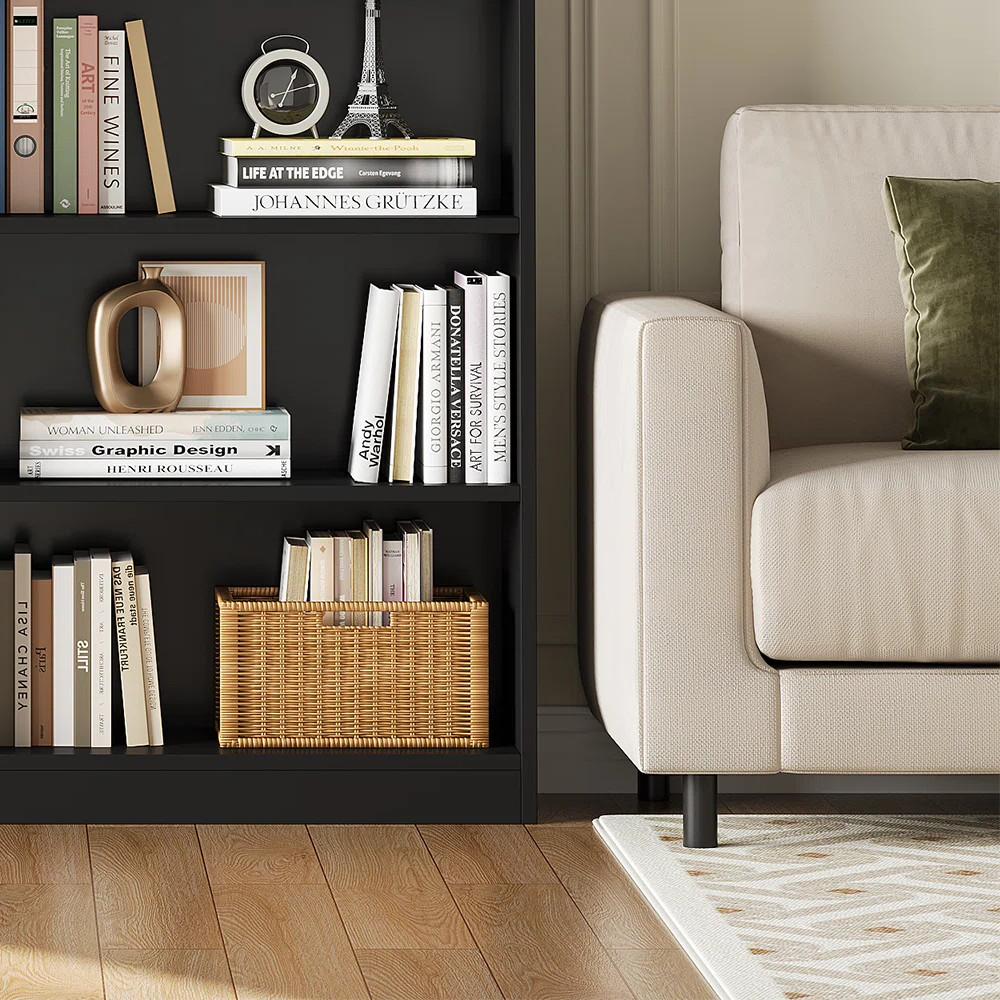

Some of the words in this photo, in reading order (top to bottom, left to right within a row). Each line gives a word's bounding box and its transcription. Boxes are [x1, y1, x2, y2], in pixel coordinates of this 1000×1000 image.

[81, 62, 95, 93] ART
[104, 56, 119, 105] FINE
[104, 116, 119, 189] WINES
[242, 166, 267, 179] LIFE
[268, 166, 285, 179] AT
[286, 166, 310, 179] THE
[312, 166, 344, 179] EDGE
[379, 170, 402, 178] Egevang
[252, 194, 361, 212] JOHANNES
[365, 192, 464, 210] GRÜTZKE
[494, 291, 506, 358] STORIES
[431, 321, 441, 383] ARMANI
[450, 304, 461, 396] DONATELLA
[470, 361, 482, 417] SURVIVAL
[494, 361, 506, 412] STYLE
[47, 424, 96, 435] WOMAN
[99, 424, 164, 435] UNLEASHED
[192, 425, 213, 433] JENN
[359, 420, 375, 461] Andy
[368, 415, 385, 468] Warhol
[431, 388, 441, 453] GIORGIO
[450, 399, 461, 469] VERSACE
[470, 419, 482, 445] FOR
[494, 415, 506, 463] MEN'S
[29, 445, 85, 456] Swiss
[91, 444, 167, 458] Graphic
[173, 444, 238, 458] Design
[107, 464, 152, 474] HENRI
[157, 464, 234, 474] ROUSSEAU
[470, 449, 482, 472] ART
